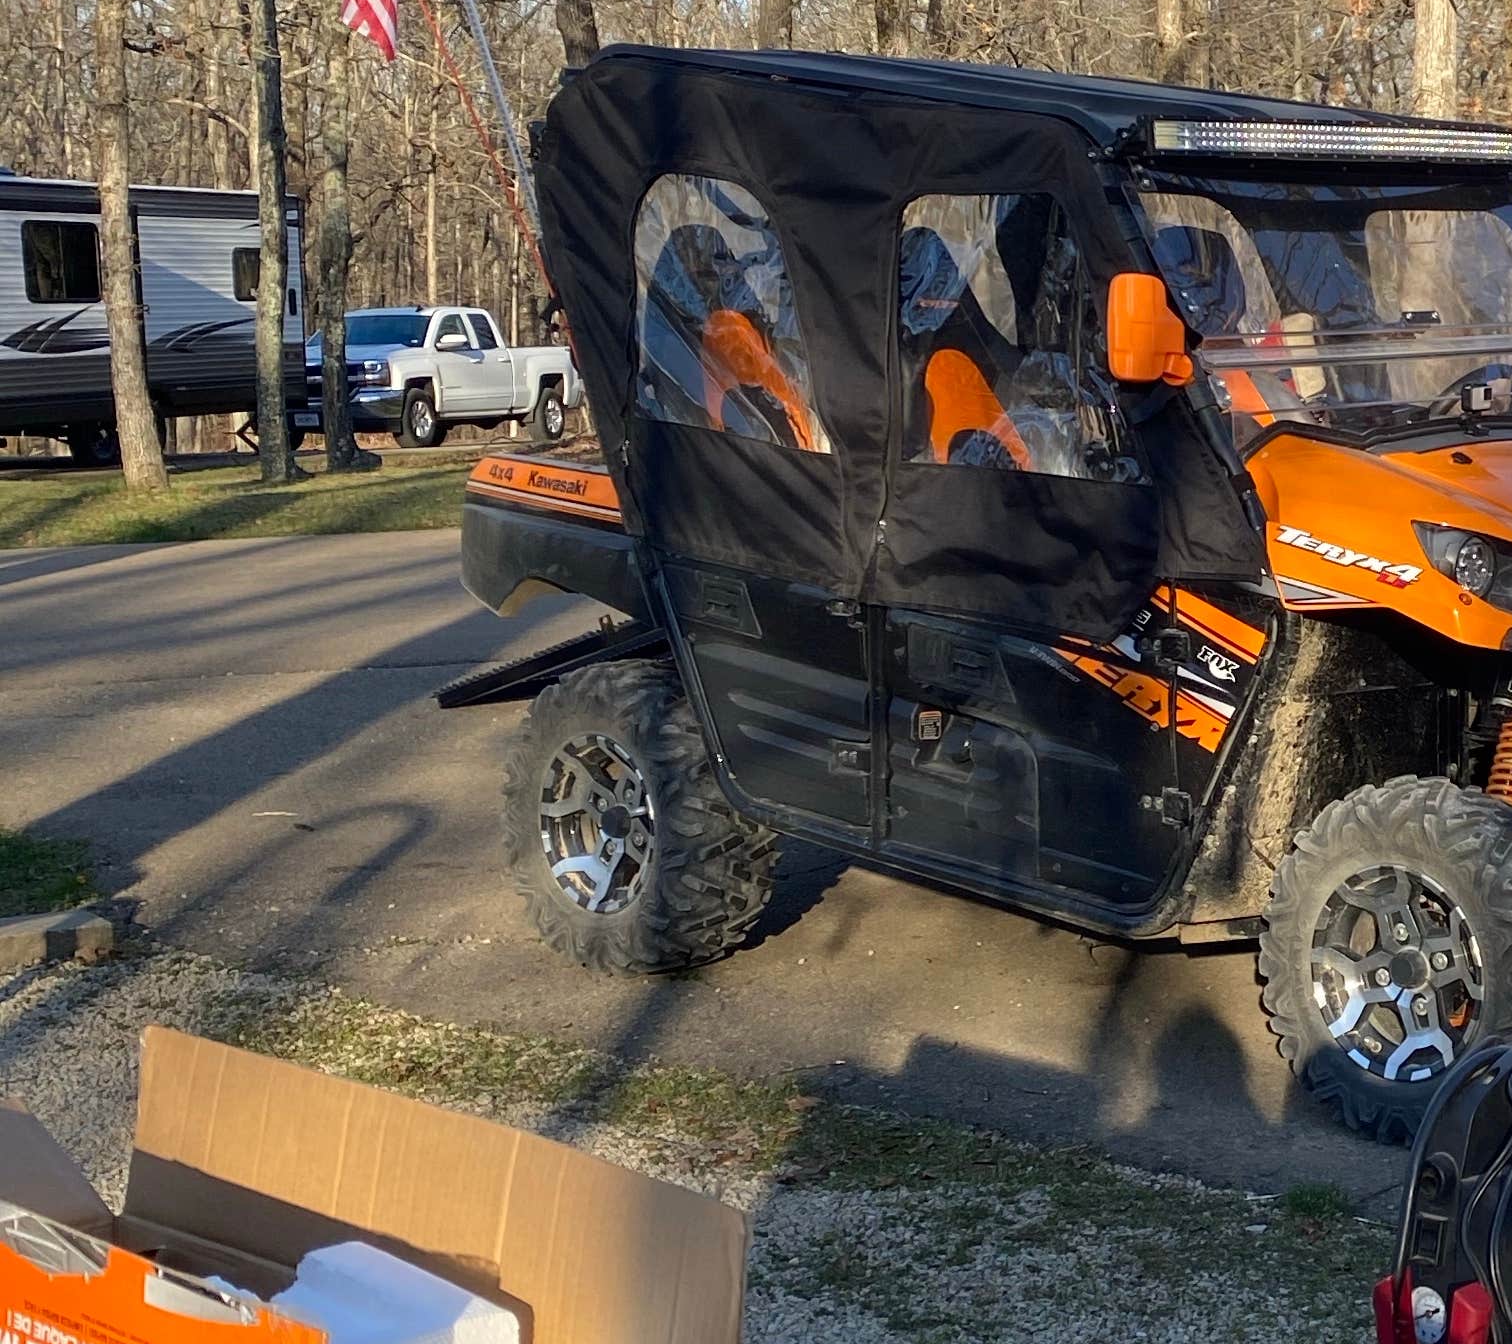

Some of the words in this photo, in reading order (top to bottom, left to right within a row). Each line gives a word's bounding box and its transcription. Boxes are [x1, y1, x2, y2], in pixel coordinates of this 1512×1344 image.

[489, 464, 514, 482] 4x4
[527, 470, 589, 496] Kawasaki
[1197, 645, 1240, 679] FOX
[14, 1311, 33, 1337] DE
